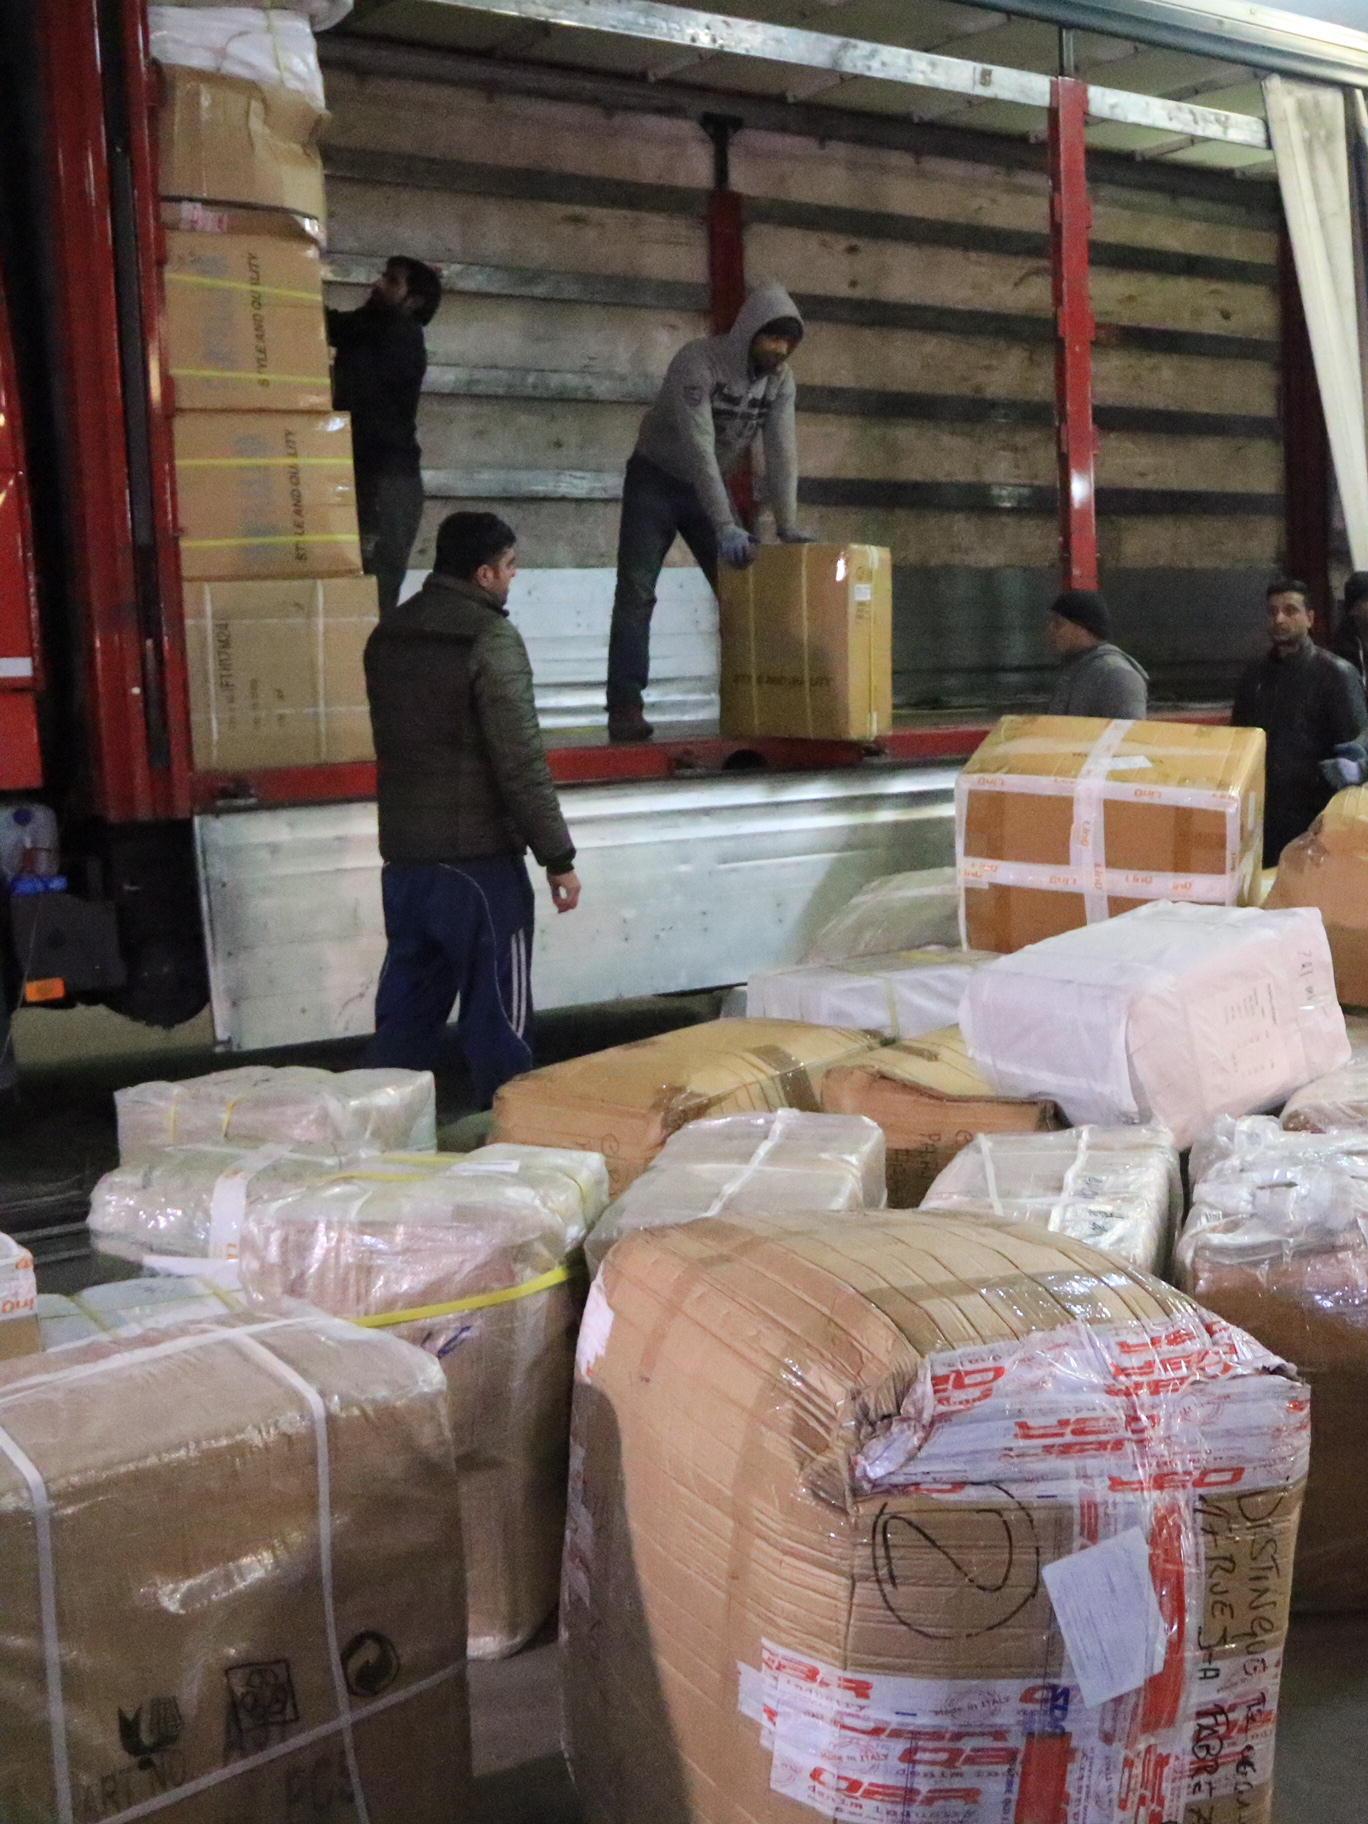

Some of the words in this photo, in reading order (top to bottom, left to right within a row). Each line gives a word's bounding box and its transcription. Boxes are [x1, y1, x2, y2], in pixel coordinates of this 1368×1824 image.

[247, 252, 262, 311] QULITY
[253, 313, 266, 343] AND
[255, 345, 270, 388] SYLE
[285, 429, 300, 487] QULITY
[290, 489, 303, 517] AND
[292, 518, 308, 563] STLE
[1205, 1553, 1237, 1621] RUE
